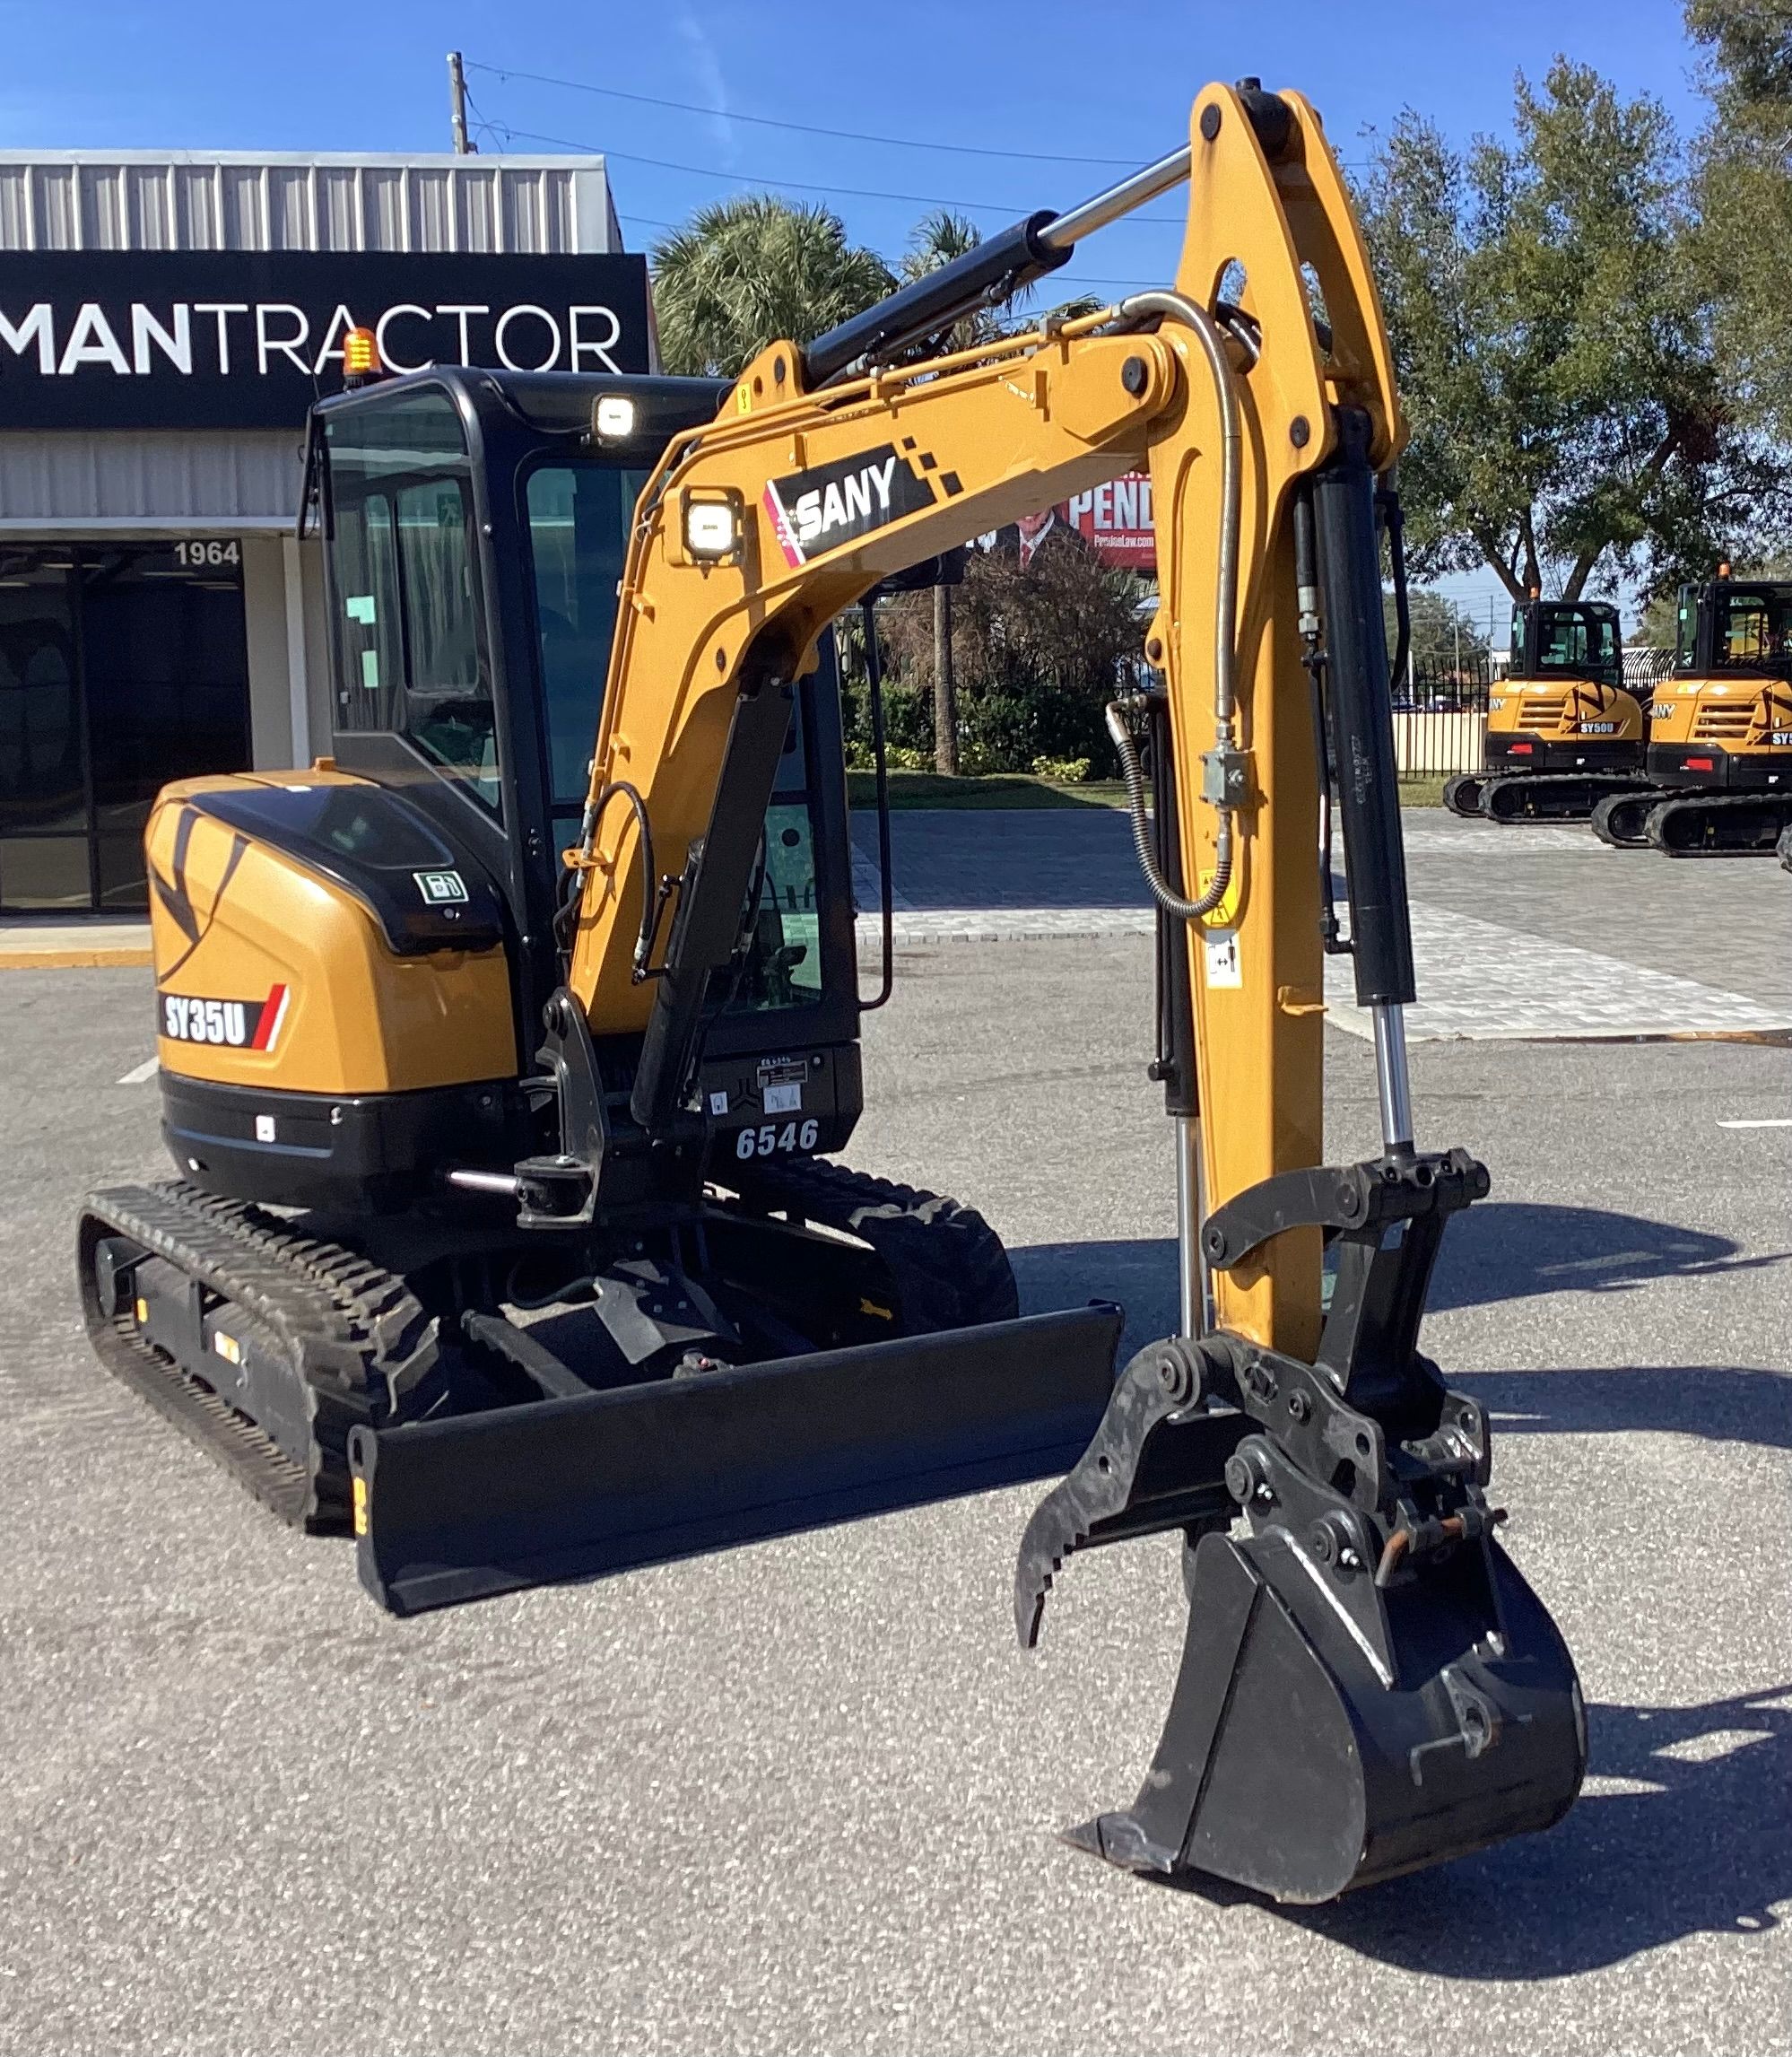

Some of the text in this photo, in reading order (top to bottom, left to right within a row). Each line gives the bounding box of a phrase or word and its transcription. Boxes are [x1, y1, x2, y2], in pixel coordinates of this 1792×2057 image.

[796, 456, 896, 541] SANY
[174, 541, 240, 566] 1964
[1580, 722, 1614, 733] SY50U
[165, 995, 246, 1045] SY35U
[736, 1119, 819, 1160] 6546
